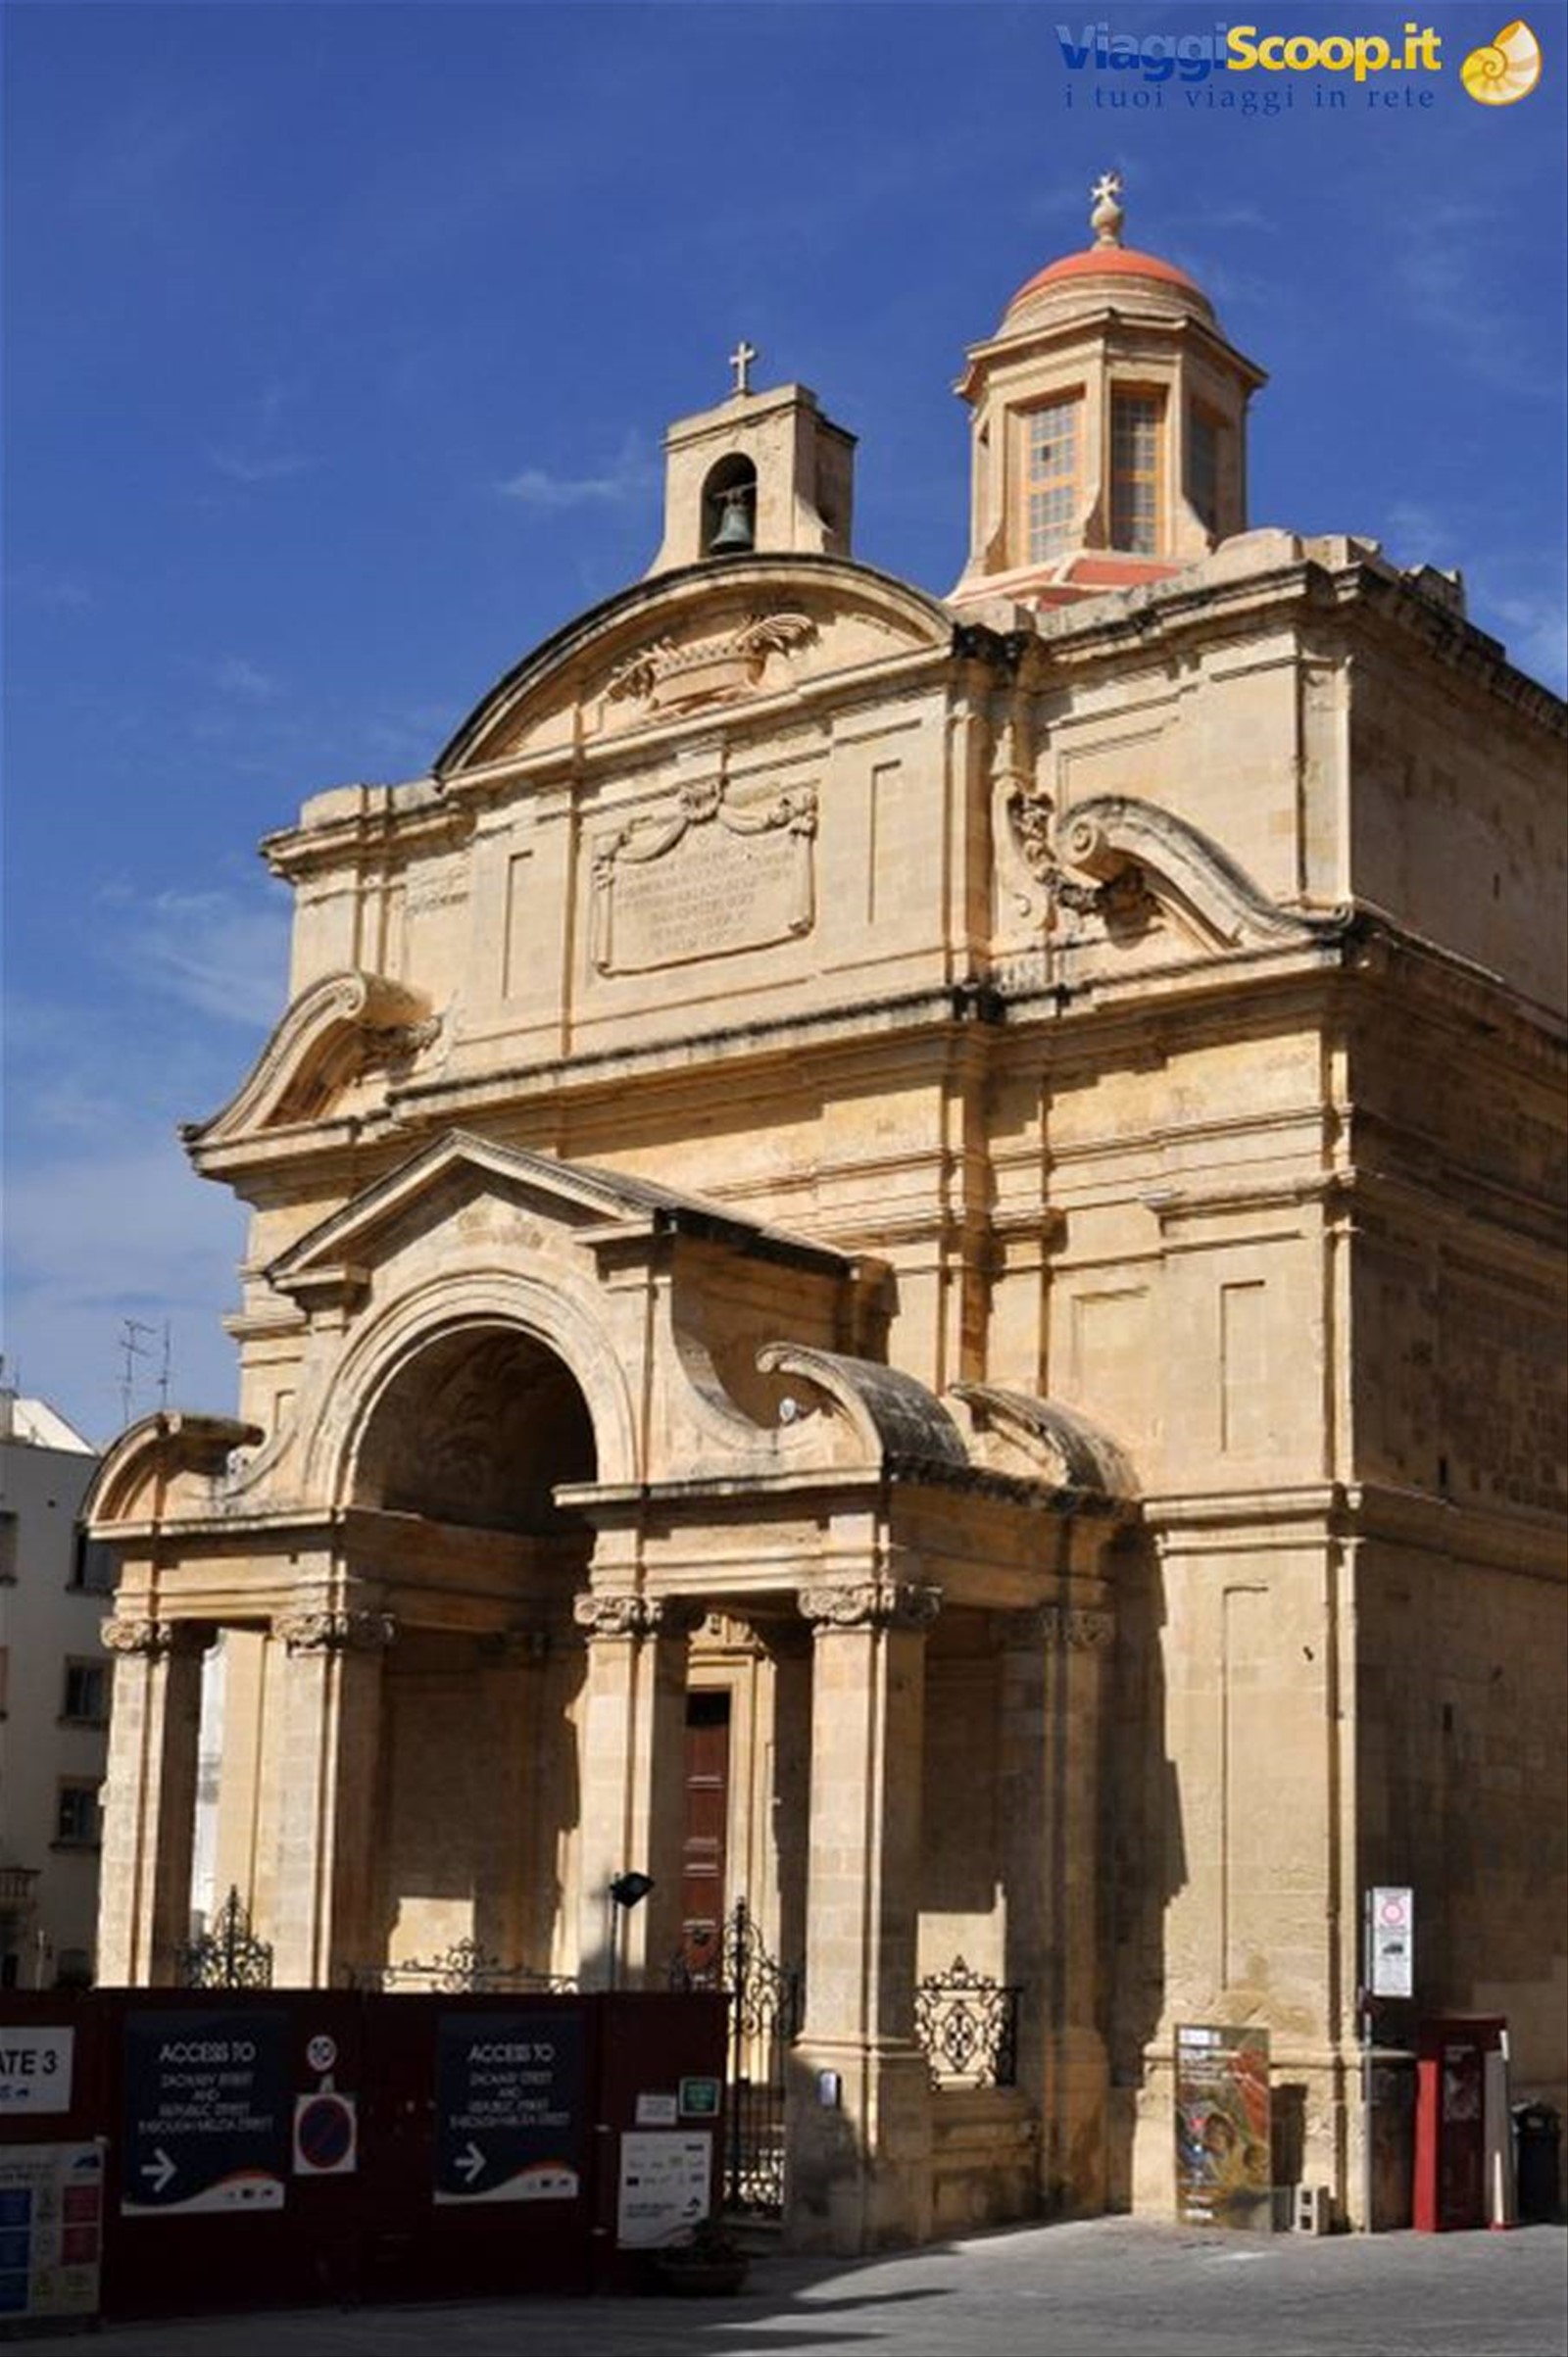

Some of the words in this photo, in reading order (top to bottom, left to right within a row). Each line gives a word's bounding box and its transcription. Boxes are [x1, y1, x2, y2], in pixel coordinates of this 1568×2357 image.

[42, 2048, 58, 2076] 3
[159, 2041, 230, 2063] ACCESS
[232, 2041, 256, 2062] TO
[468, 2044, 531, 2064] ACCESS
